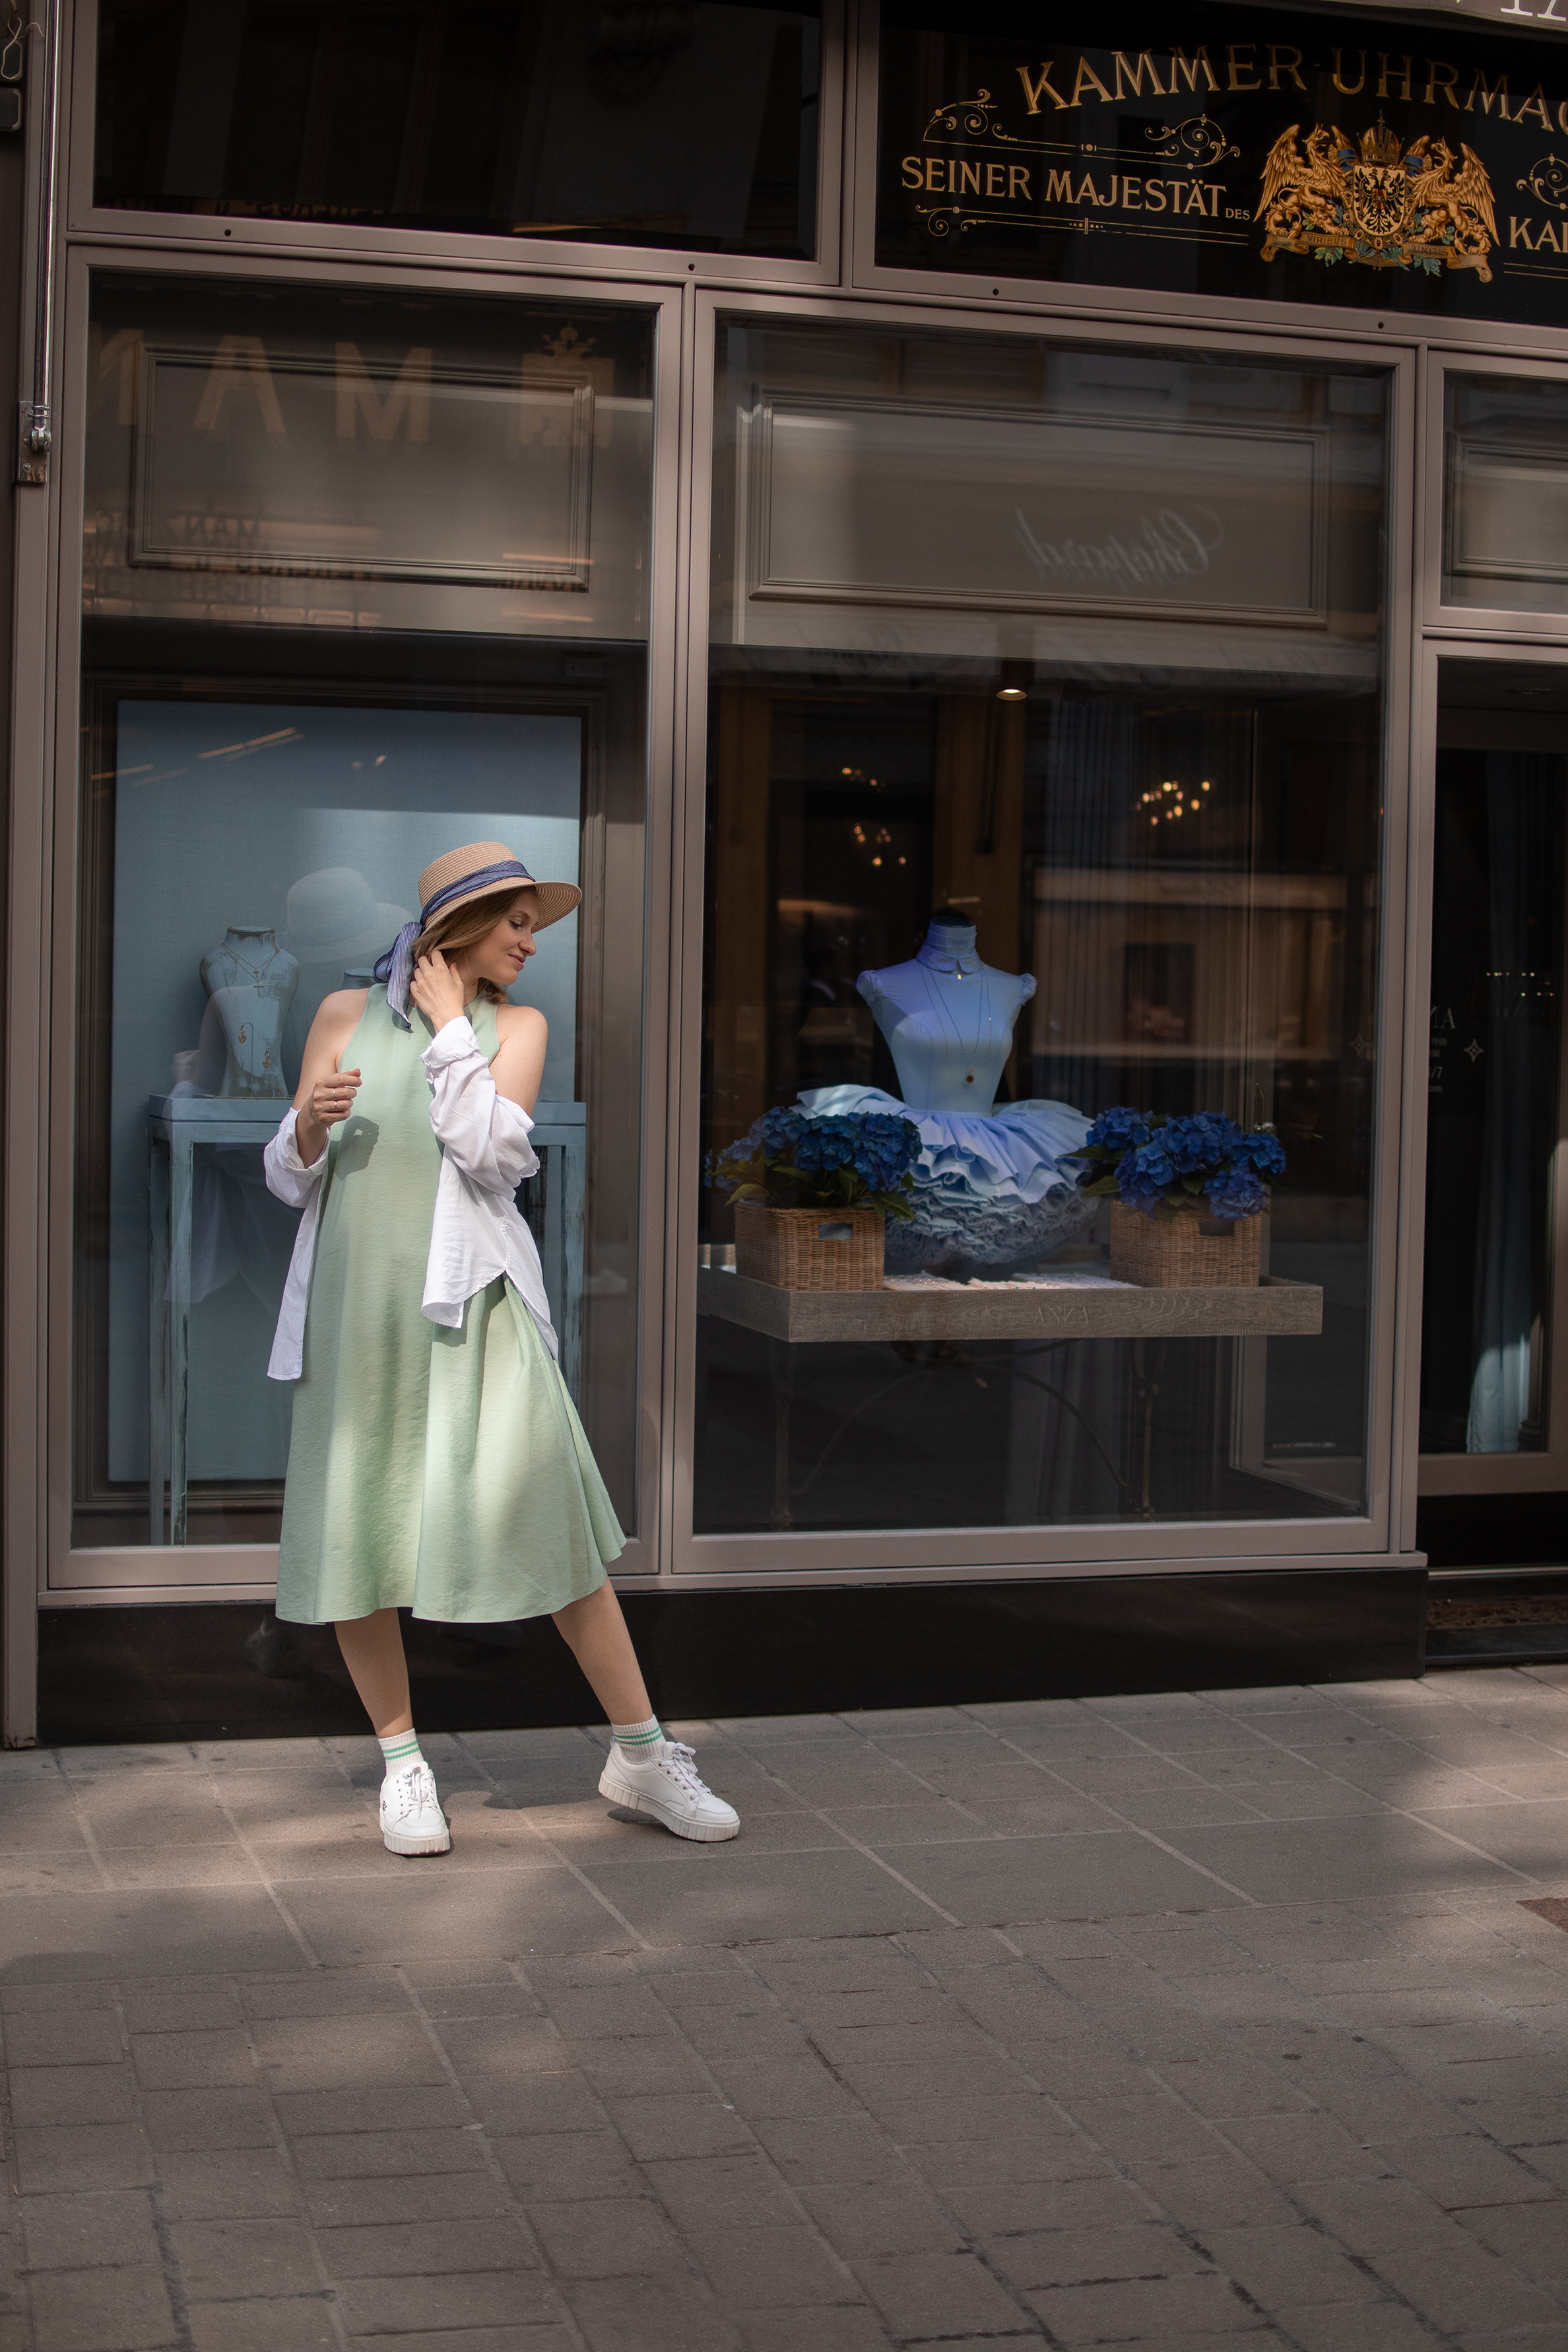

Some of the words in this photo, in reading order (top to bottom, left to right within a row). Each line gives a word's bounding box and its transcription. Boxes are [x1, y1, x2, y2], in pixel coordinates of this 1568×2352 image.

[1016, 44, 1568, 137] KAMMER-UHRMA
[901, 156, 1032, 201] SEINER
[1045, 168, 1226, 217] MAJESTÄT
[1225, 207, 1250, 220] DES
[1307, 234, 1347, 246] VIRIBUS
[1413, 246, 1449, 256] UNITIS
